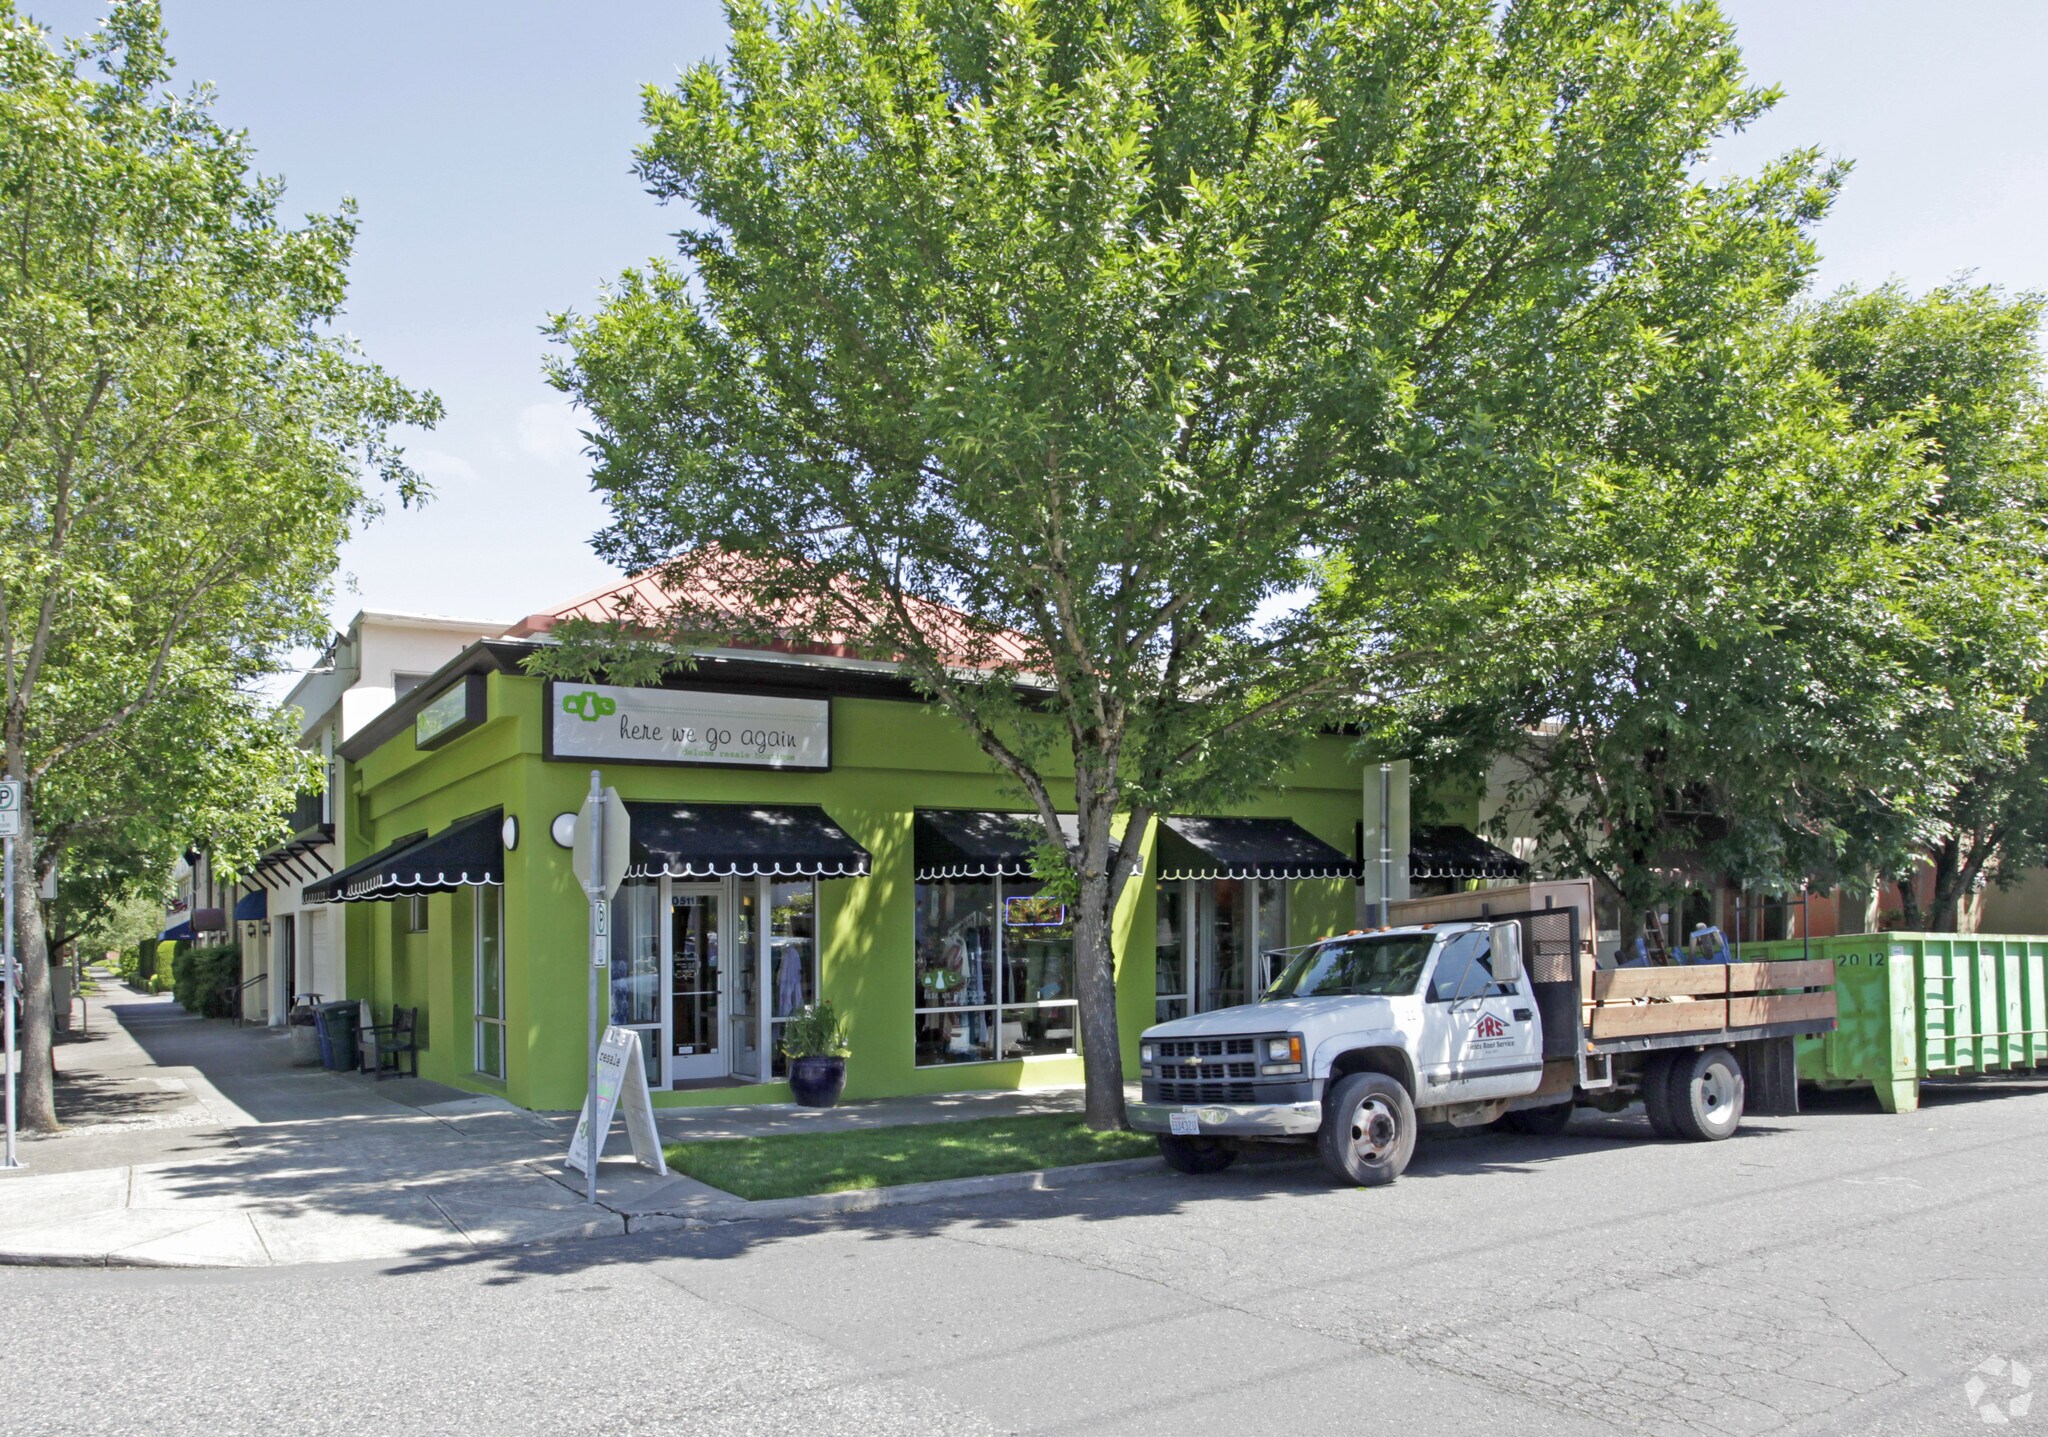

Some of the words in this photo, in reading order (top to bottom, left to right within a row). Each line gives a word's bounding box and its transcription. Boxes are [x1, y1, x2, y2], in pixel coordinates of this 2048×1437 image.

[620, 714, 663, 741] here
[672, 727, 697, 743] we
[706, 727, 731, 751] go
[741, 729, 796, 754] again
[682, 747, 714, 757] deluxe
[720, 750, 751, 759] resale
[0, 790, 9, 804] P
[1477, 1016, 1504, 1038] FRS
[1496, 1041, 1515, 1049] Service
